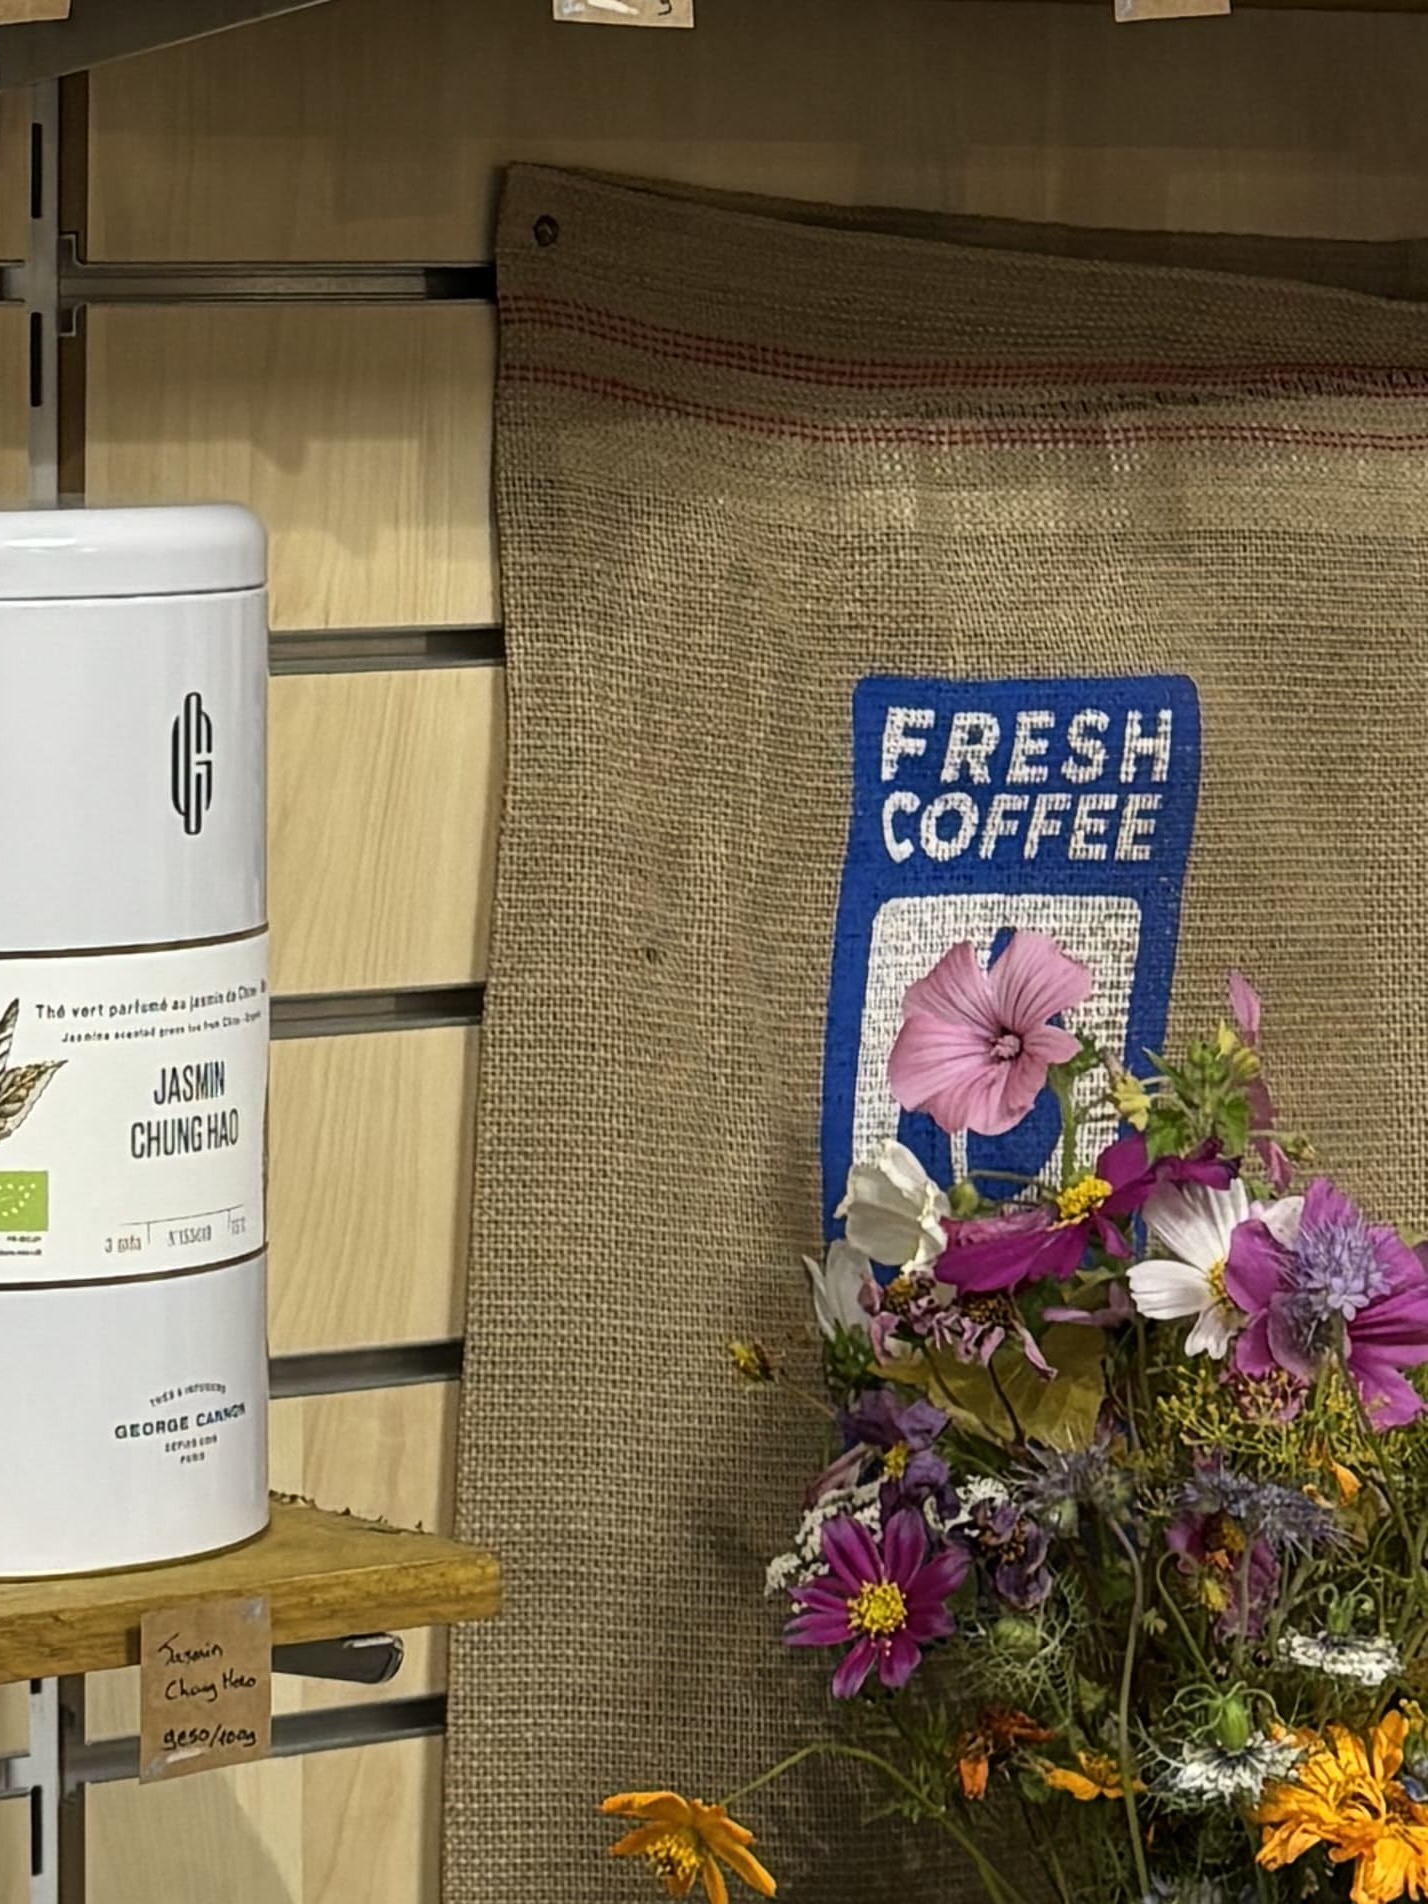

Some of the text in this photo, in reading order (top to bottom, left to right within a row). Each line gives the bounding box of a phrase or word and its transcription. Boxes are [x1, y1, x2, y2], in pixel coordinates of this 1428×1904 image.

[880, 705, 1173, 785] FRESH
[881, 791, 1163, 862] COFFEE
[154, 1061, 224, 1105] JASMIN
[131, 1109, 238, 1158] CHUNG HAO
[115, 1416, 188, 1439] GEORGE
